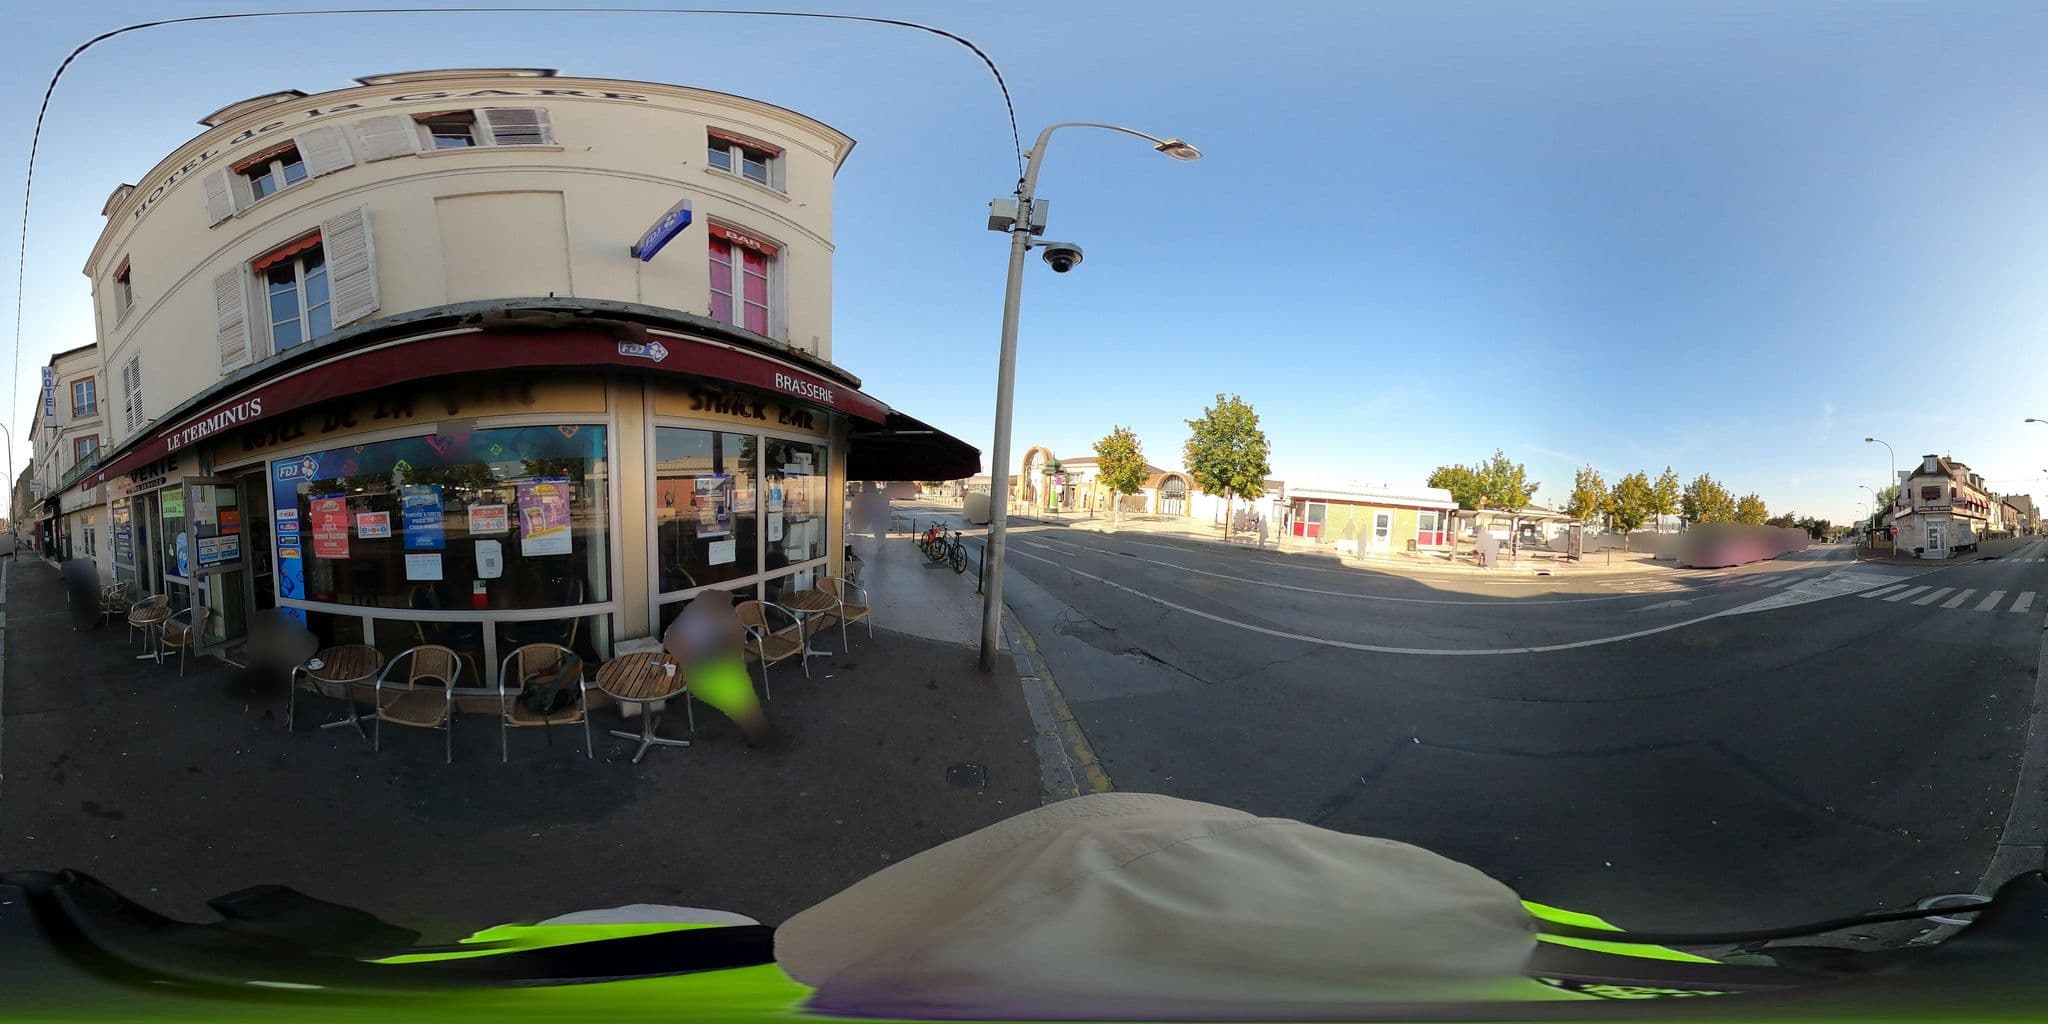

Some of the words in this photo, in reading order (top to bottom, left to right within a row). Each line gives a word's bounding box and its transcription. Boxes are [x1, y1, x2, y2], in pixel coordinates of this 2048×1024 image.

[134, 150, 219, 221] HOTEL
[230, 122, 284, 144] de
[305, 103, 365, 117] la
[390, 89, 649, 102] GARE
[725, 230, 762, 249] BAR
[622, 344, 645, 355] FDJ
[44, 369, 53, 417] HOTEL
[775, 372, 835, 404] BRASSERIE
[167, 433, 181, 452] LE
[181, 398, 263, 445] TERMINUS
[279, 465, 298, 478] FDJ
